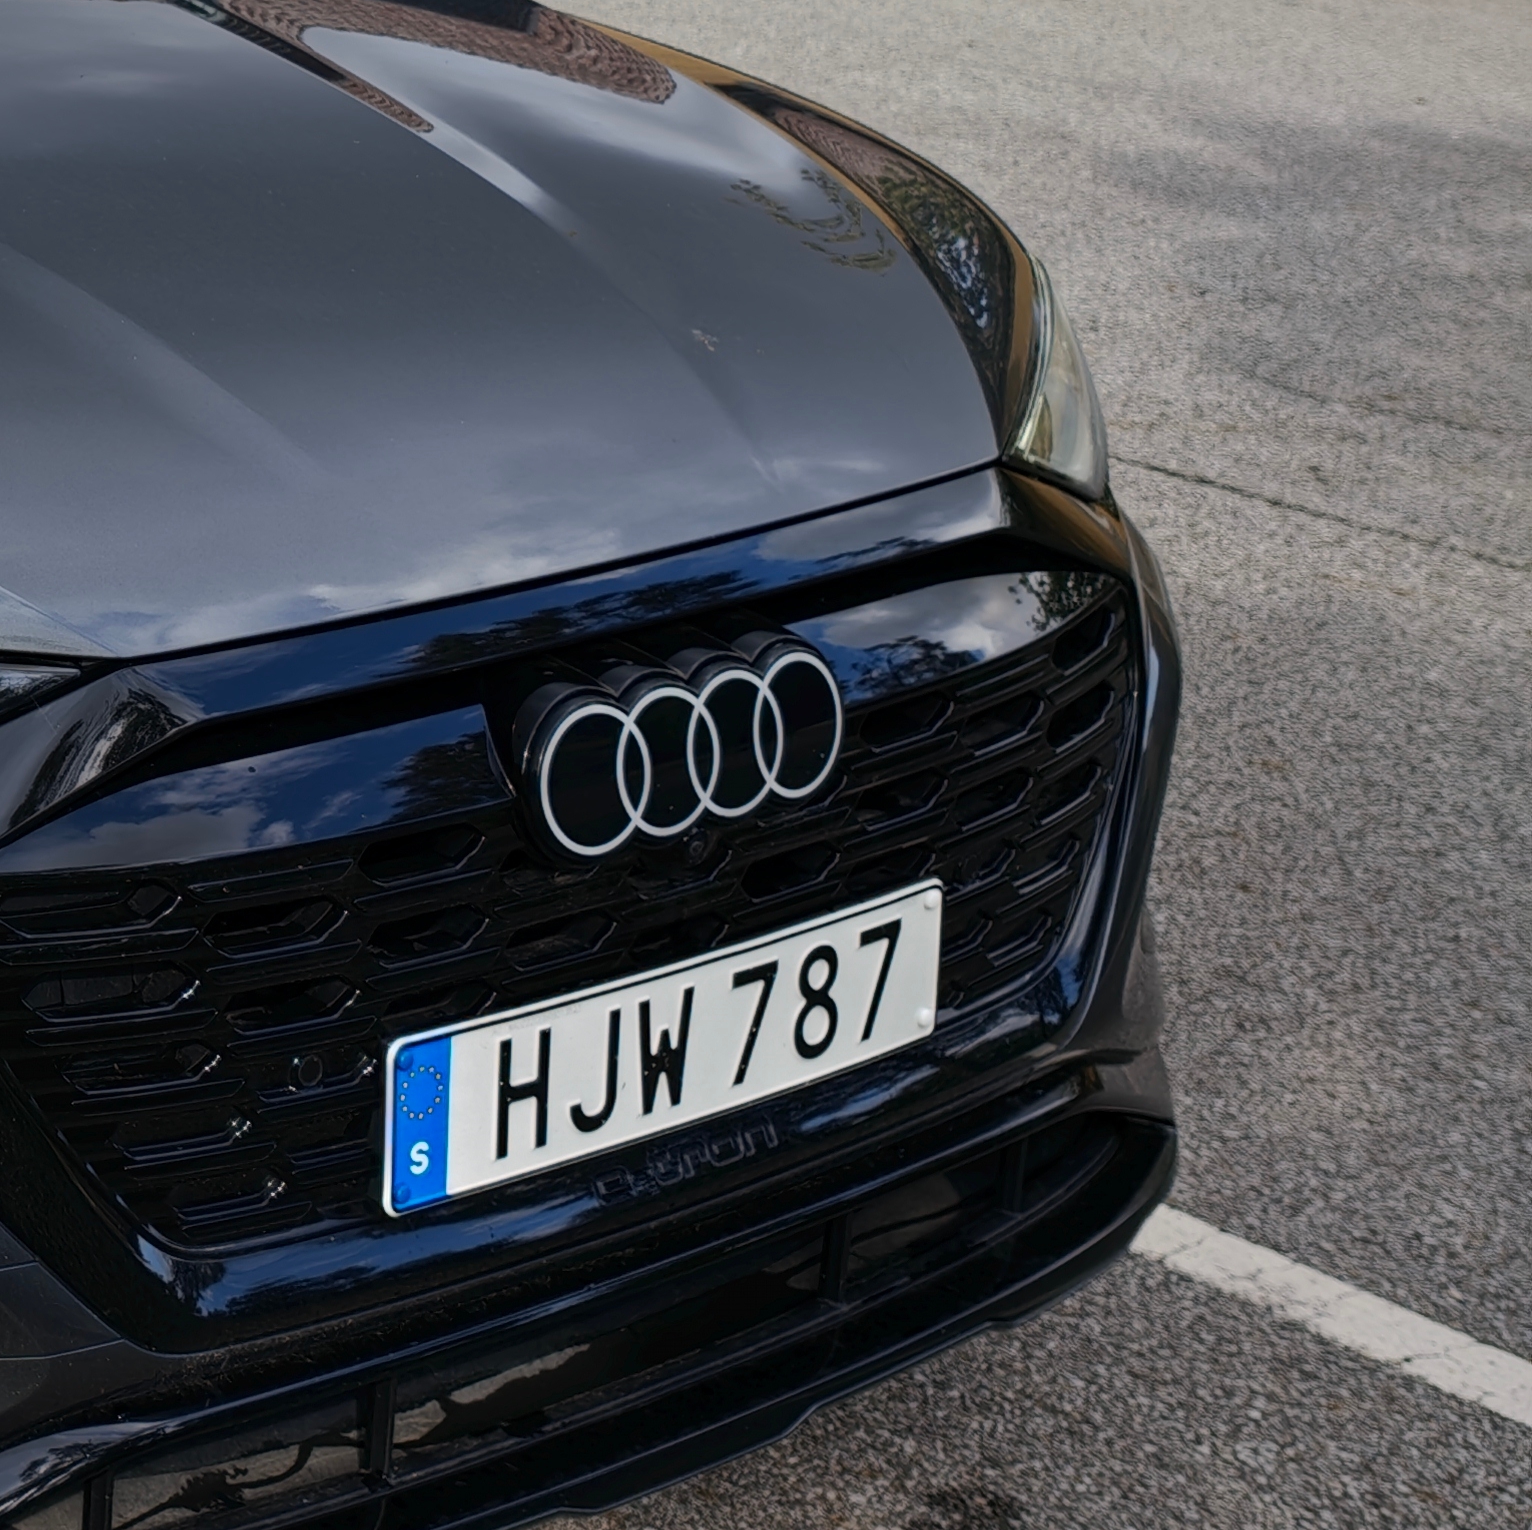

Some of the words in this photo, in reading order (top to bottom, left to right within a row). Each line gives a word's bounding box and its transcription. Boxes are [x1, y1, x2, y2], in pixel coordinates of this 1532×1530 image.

[495, 986, 695, 1160] HJW
[730, 918, 903, 1088] 787
[409, 1140, 430, 1176] S
